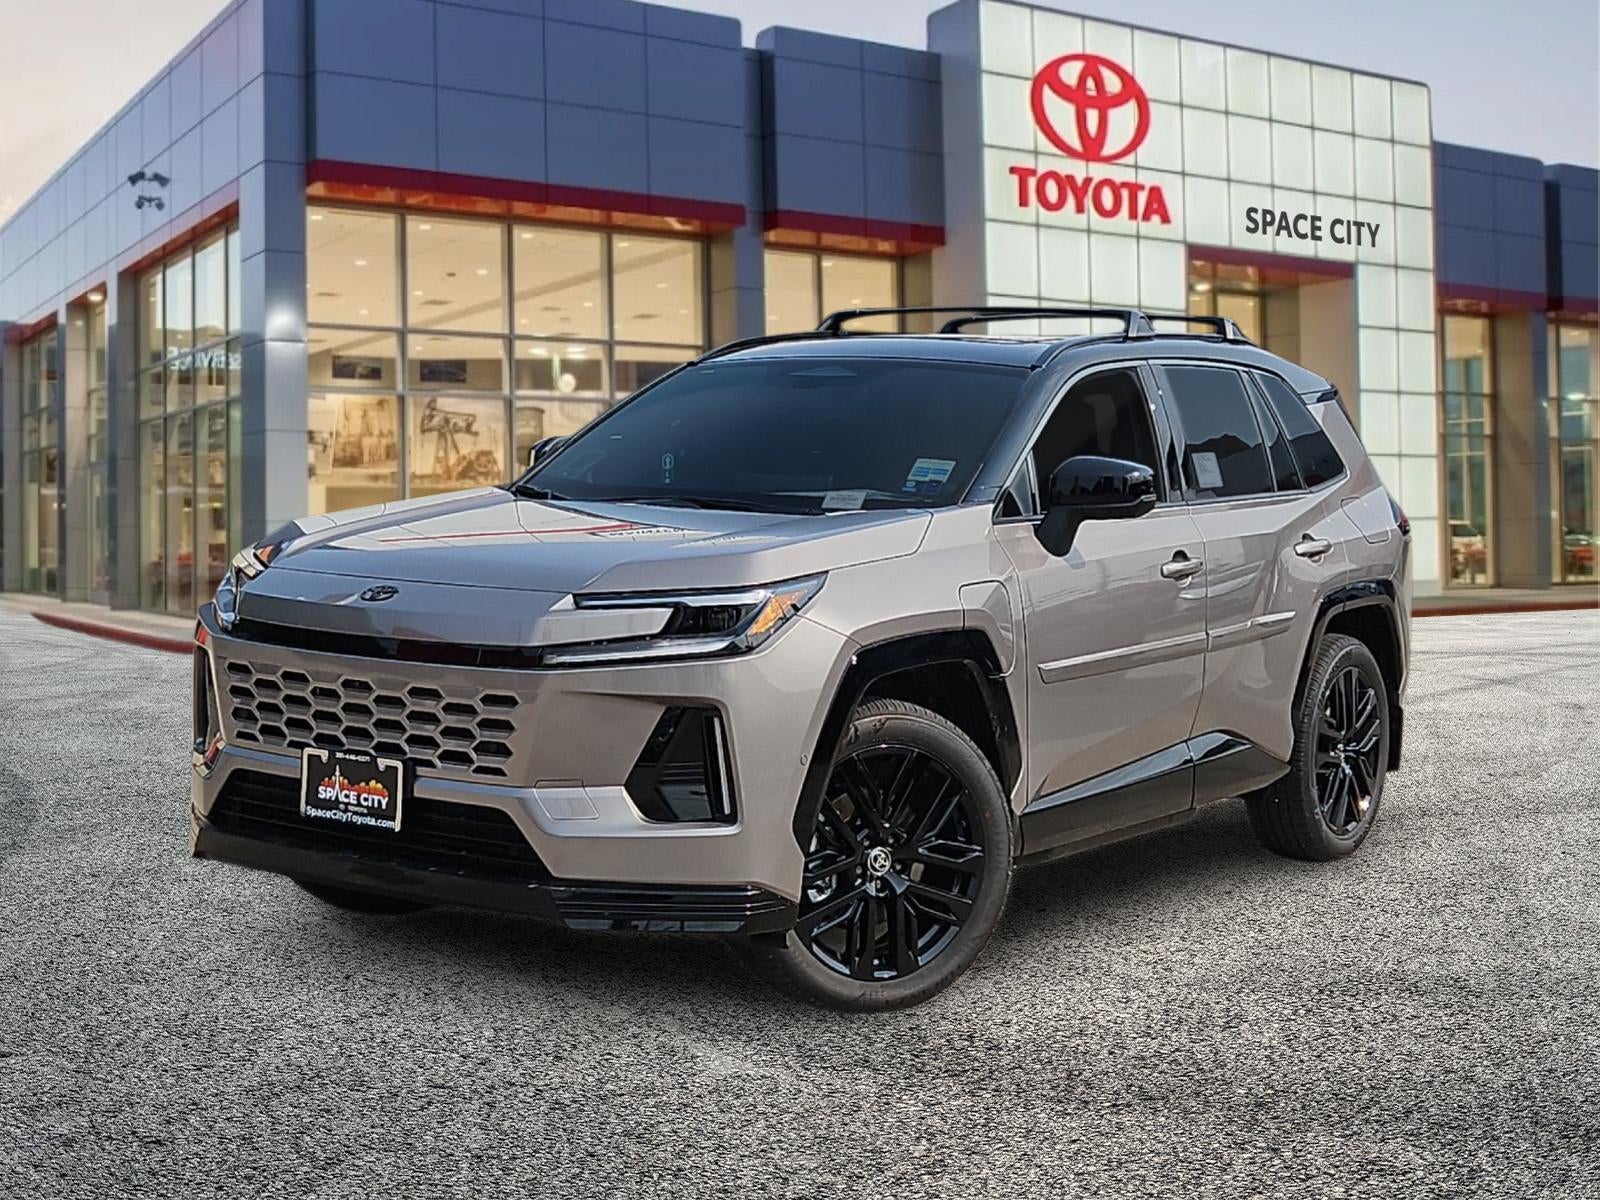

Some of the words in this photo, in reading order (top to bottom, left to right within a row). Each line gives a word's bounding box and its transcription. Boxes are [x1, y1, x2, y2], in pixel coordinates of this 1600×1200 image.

[1009, 166, 1171, 224] TOYOTA
[1245, 206, 1322, 242] SPACE
[1330, 217, 1381, 248] CITY
[318, 785, 358, 805] SPACE
[360, 792, 389, 810] CITY
[306, 805, 396, 829] SpaceCityToyota.com
